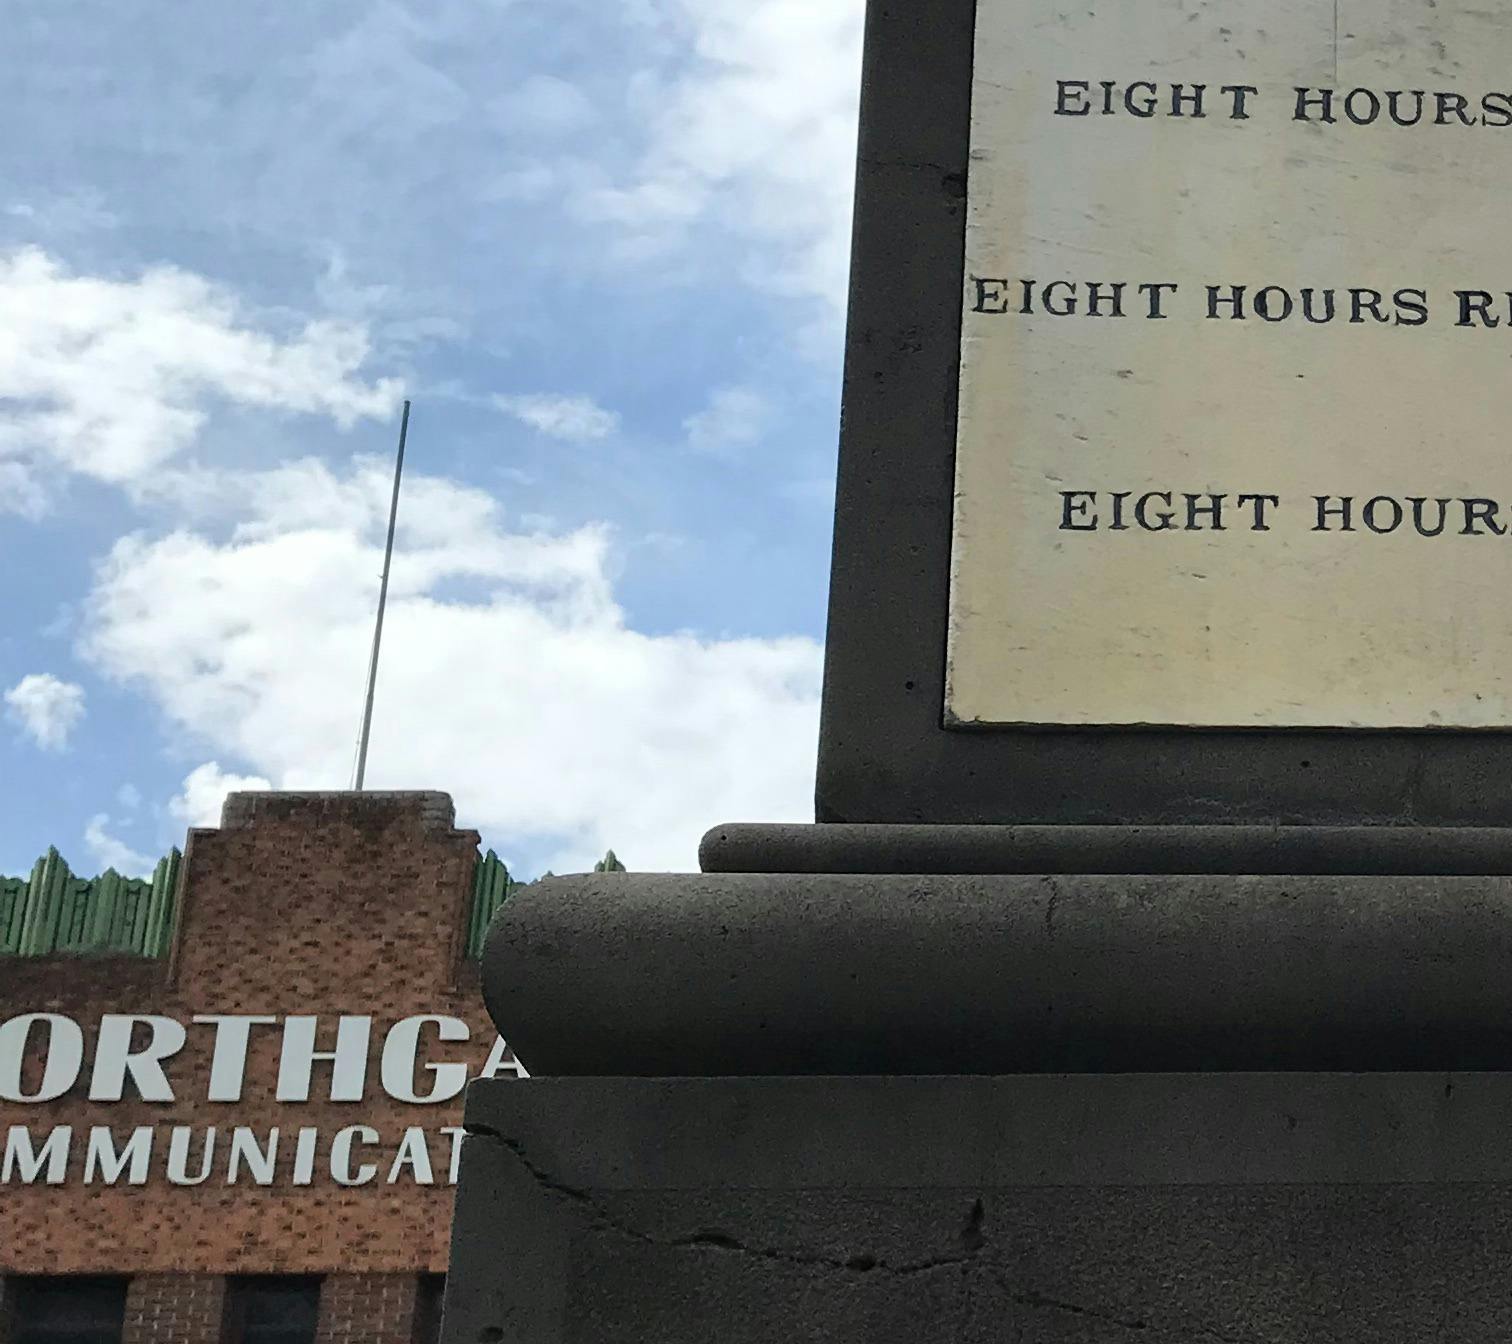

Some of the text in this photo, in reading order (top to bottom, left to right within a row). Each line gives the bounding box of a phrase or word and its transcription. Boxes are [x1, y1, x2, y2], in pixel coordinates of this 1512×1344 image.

[1052, 78, 1260, 122] EIGHT
[970, 277, 1179, 320] EIGHT
[1204, 283, 1430, 327] HOURS
[1056, 489, 1280, 533] EIGHT
